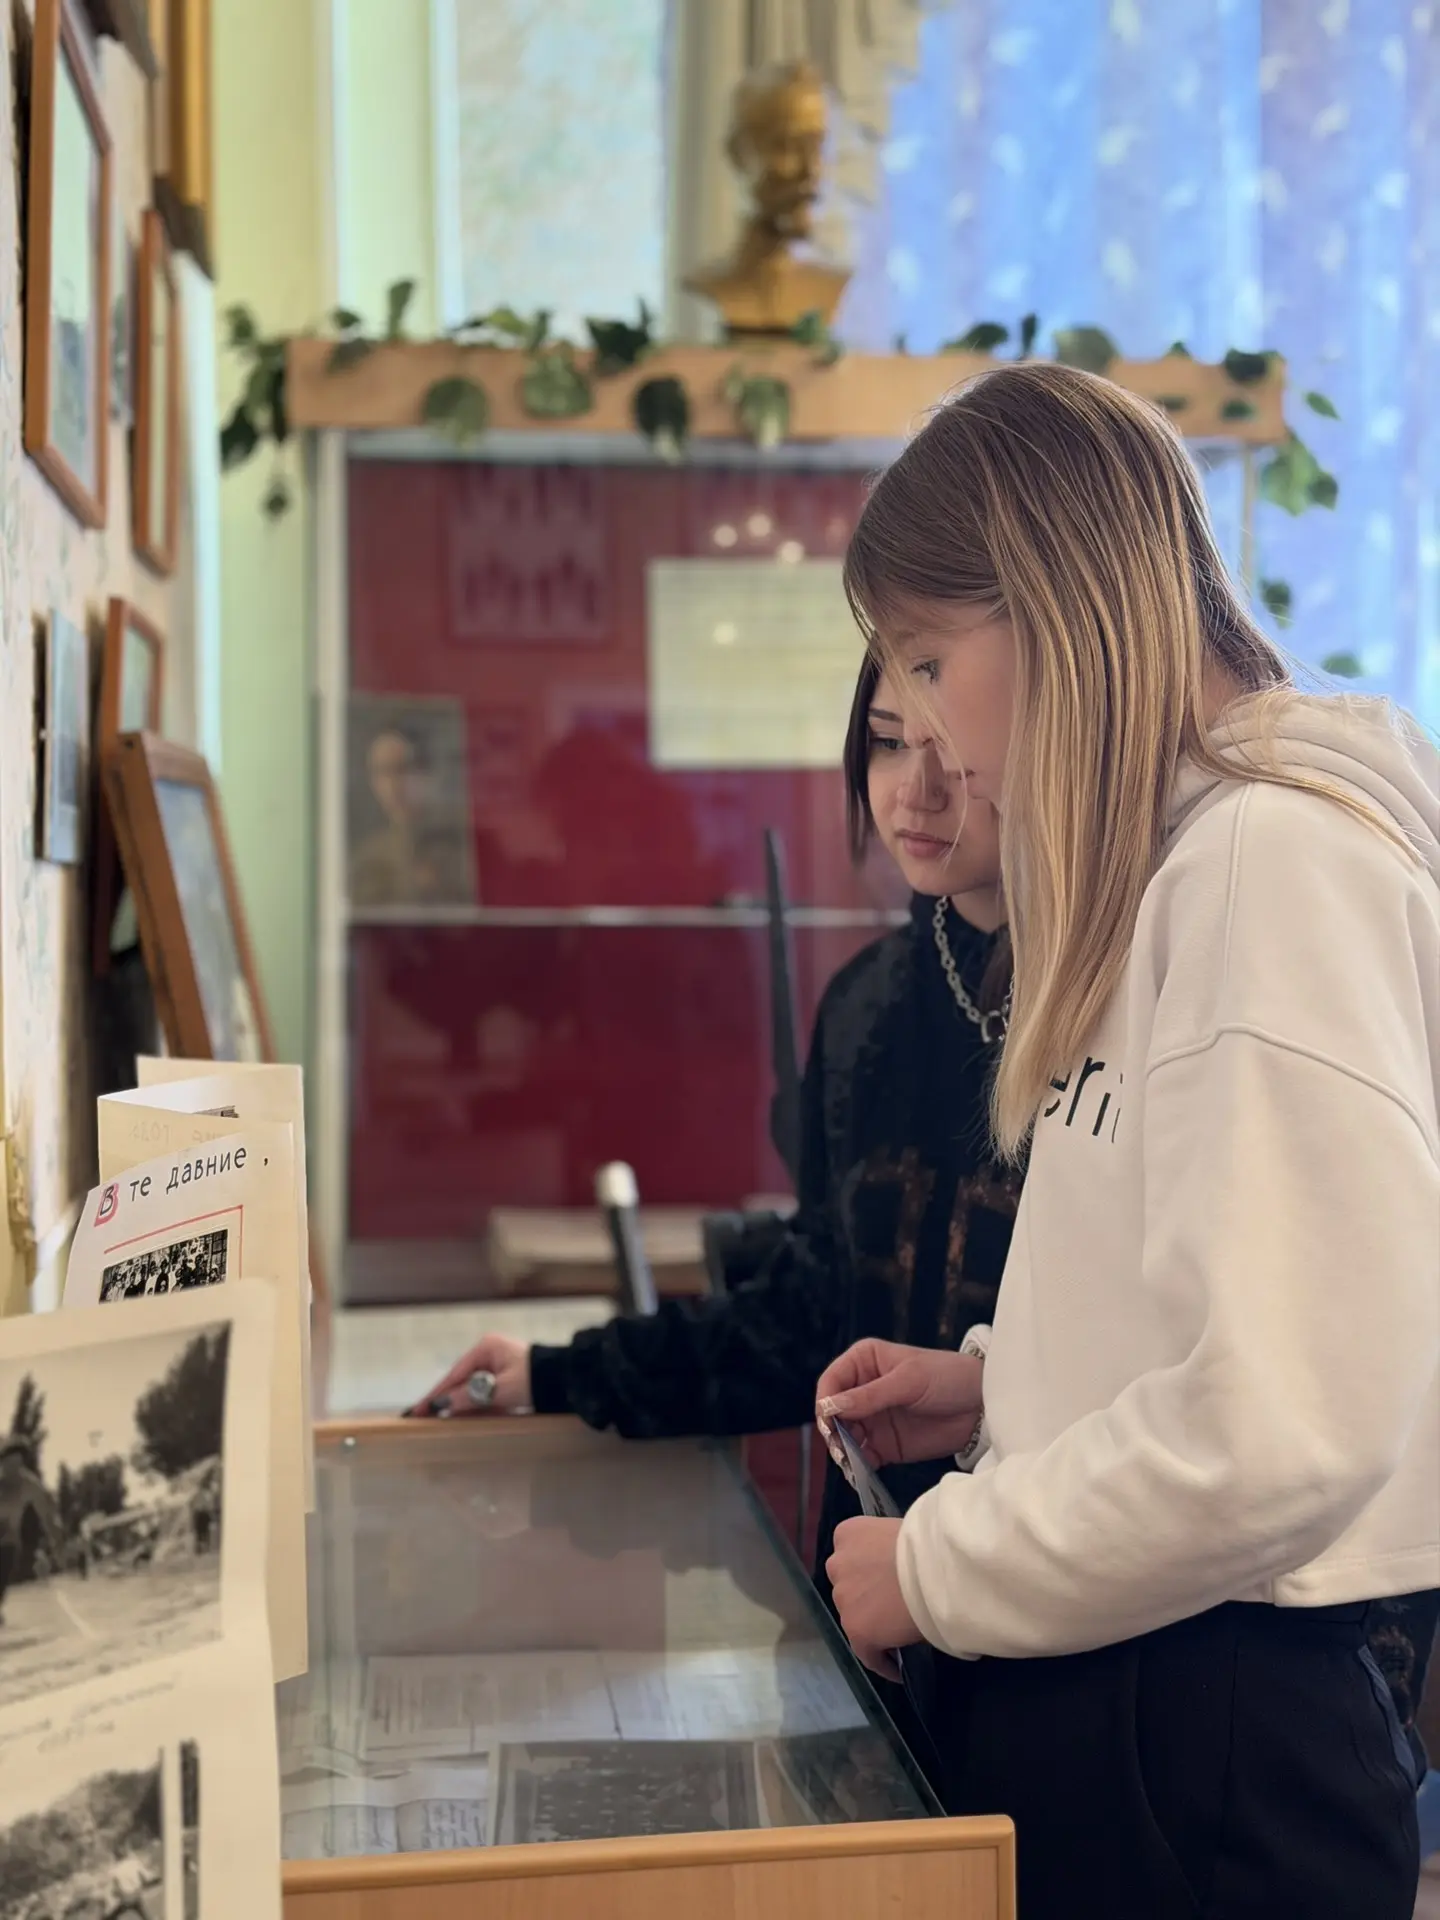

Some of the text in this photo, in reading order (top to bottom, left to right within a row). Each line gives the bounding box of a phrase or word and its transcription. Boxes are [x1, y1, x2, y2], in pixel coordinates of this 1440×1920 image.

[94, 1183, 119, 1227] В
[130, 1176, 152, 1201] те
[166, 1147, 246, 1195] давние
